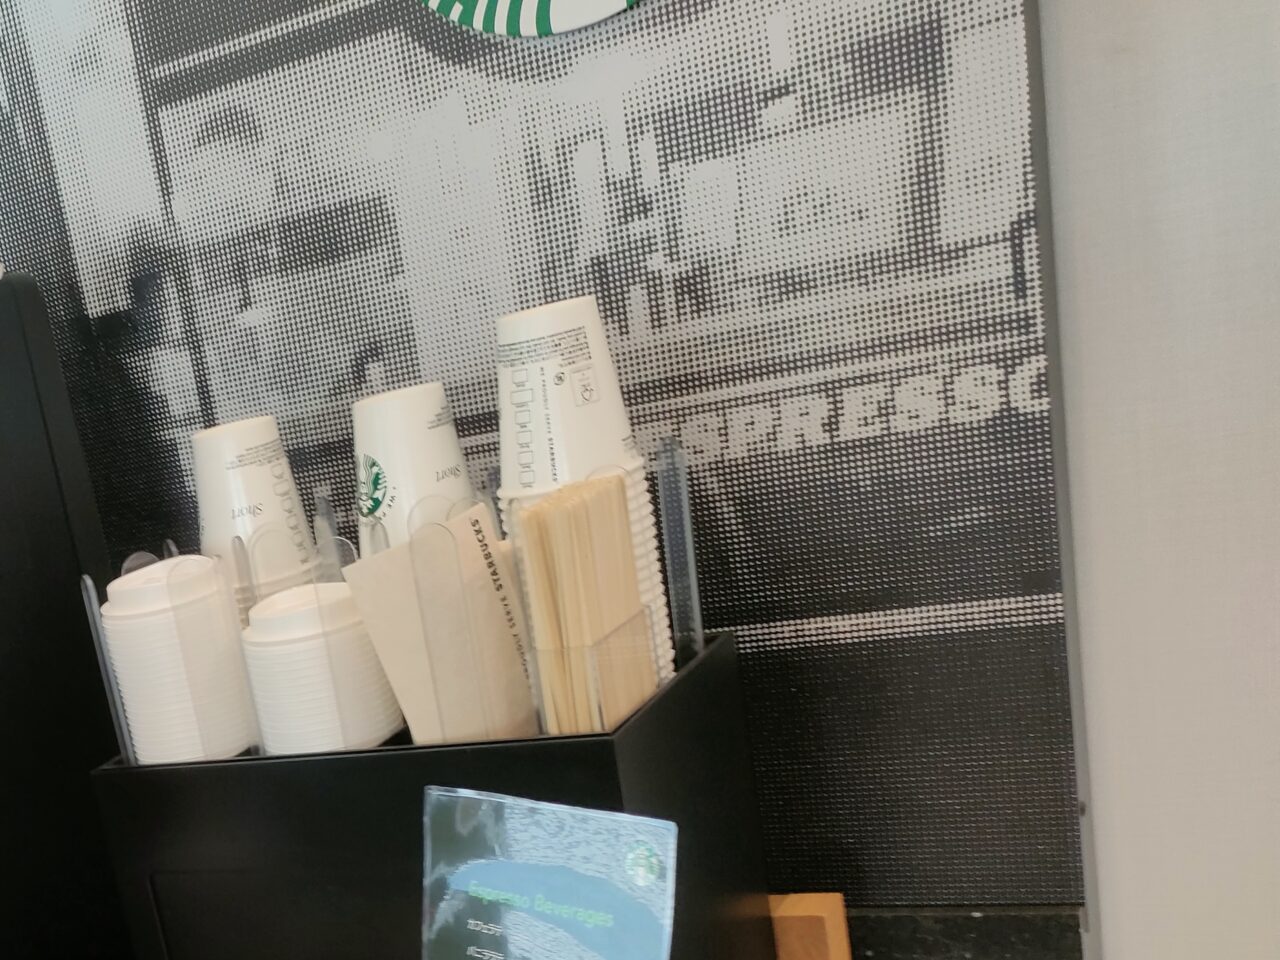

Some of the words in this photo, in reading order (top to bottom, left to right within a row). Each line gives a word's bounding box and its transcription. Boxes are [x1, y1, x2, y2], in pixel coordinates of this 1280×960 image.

[470, 517, 504, 593] STARBUCKS
[468, 880, 531, 909] Espresso
[533, 894, 615, 929] Beverages
